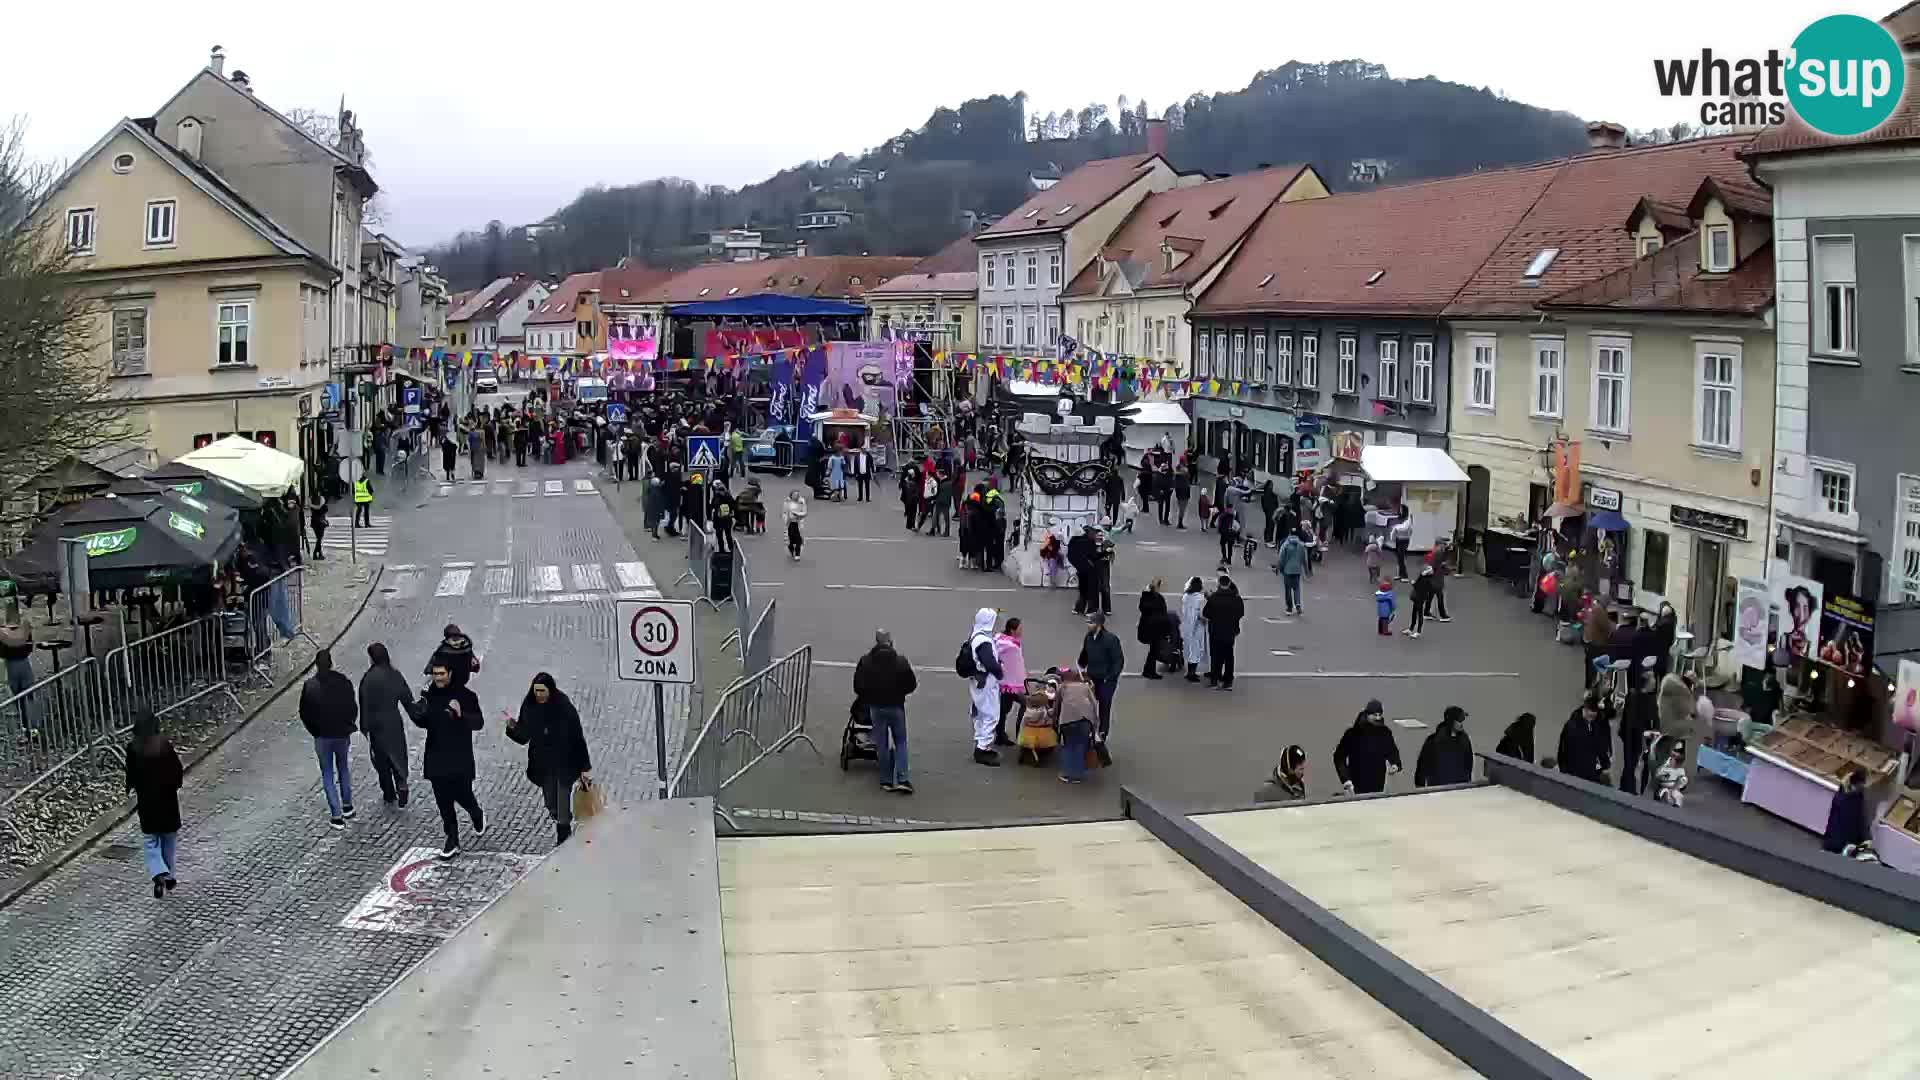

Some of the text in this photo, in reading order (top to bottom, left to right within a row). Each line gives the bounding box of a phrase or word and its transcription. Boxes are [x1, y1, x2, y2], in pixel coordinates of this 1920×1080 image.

[408, 391, 415, 402] P
[643, 622, 667, 643] 30
[634, 659, 678, 676] ZONA
